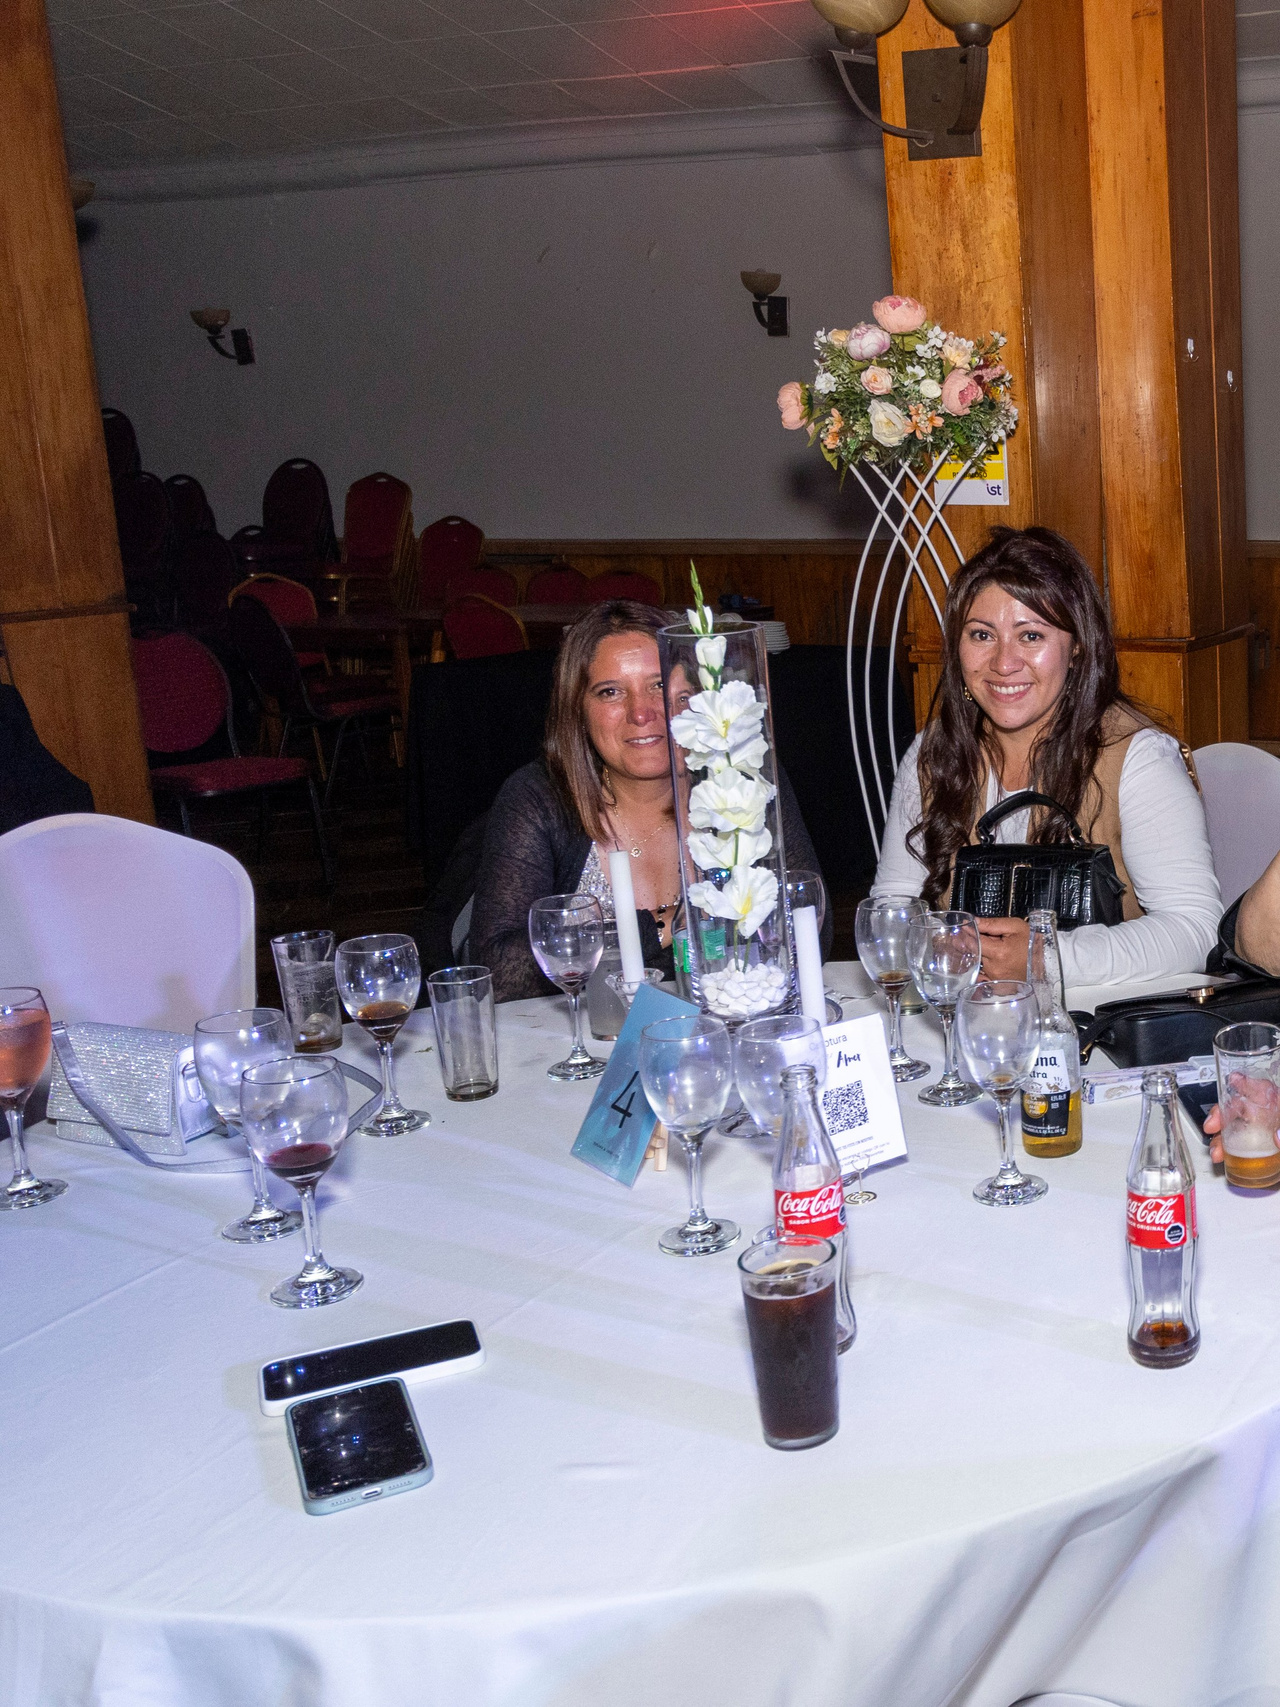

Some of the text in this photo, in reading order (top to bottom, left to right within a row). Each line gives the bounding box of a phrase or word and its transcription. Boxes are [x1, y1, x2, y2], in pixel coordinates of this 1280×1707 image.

[986, 483, 1002, 496] ist
[611, 1070, 640, 1128] 4
[778, 1181, 842, 1217] Coca-Cola
[788, 1218, 811, 1226] SABOR
